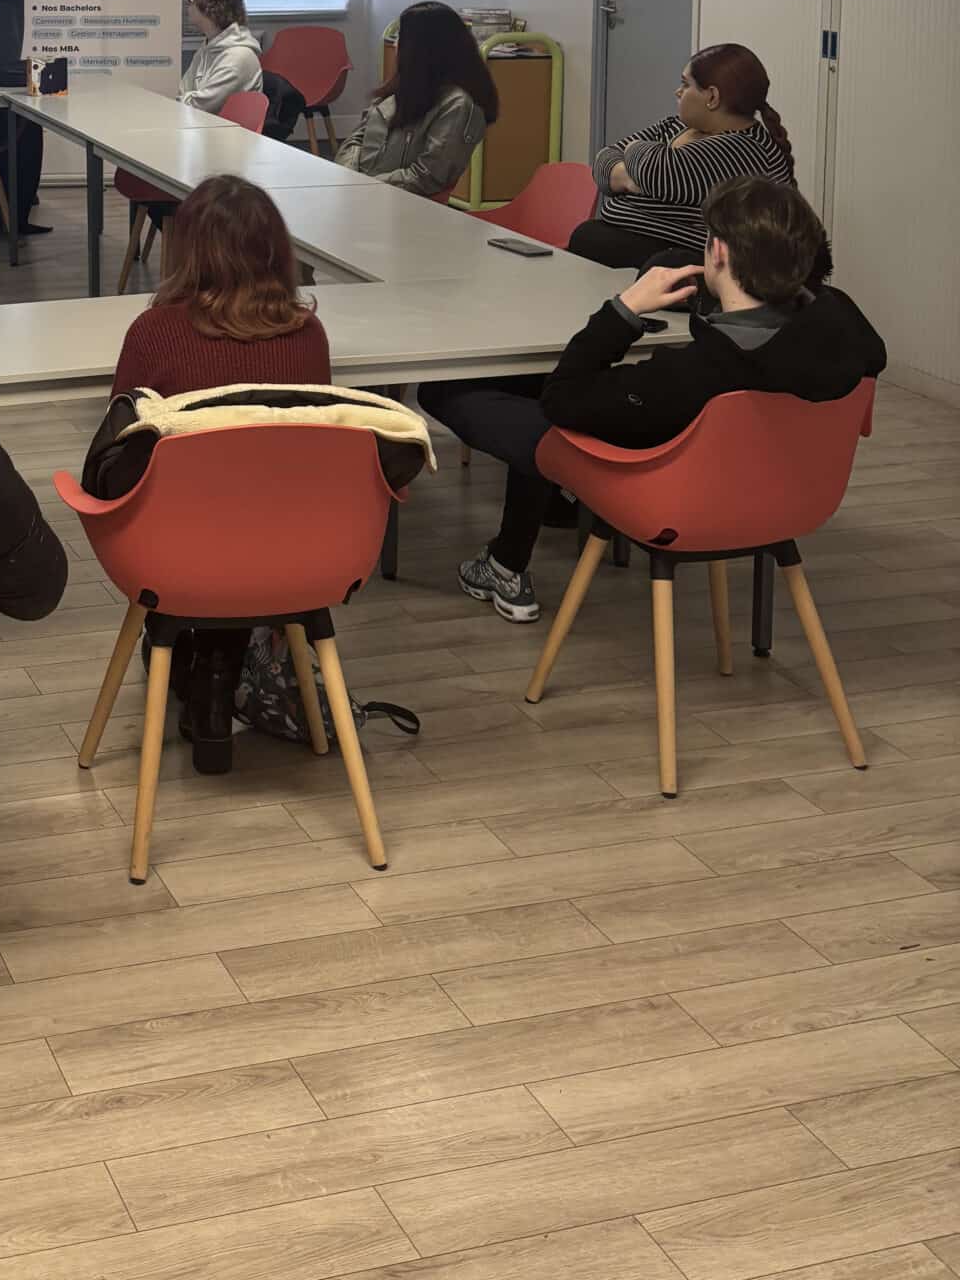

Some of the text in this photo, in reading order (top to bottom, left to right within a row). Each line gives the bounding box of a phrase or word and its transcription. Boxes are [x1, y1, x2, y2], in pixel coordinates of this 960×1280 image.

[41, 4, 102, 12] Nos Bachelors
[41, 45, 80, 53] Nos MBA
